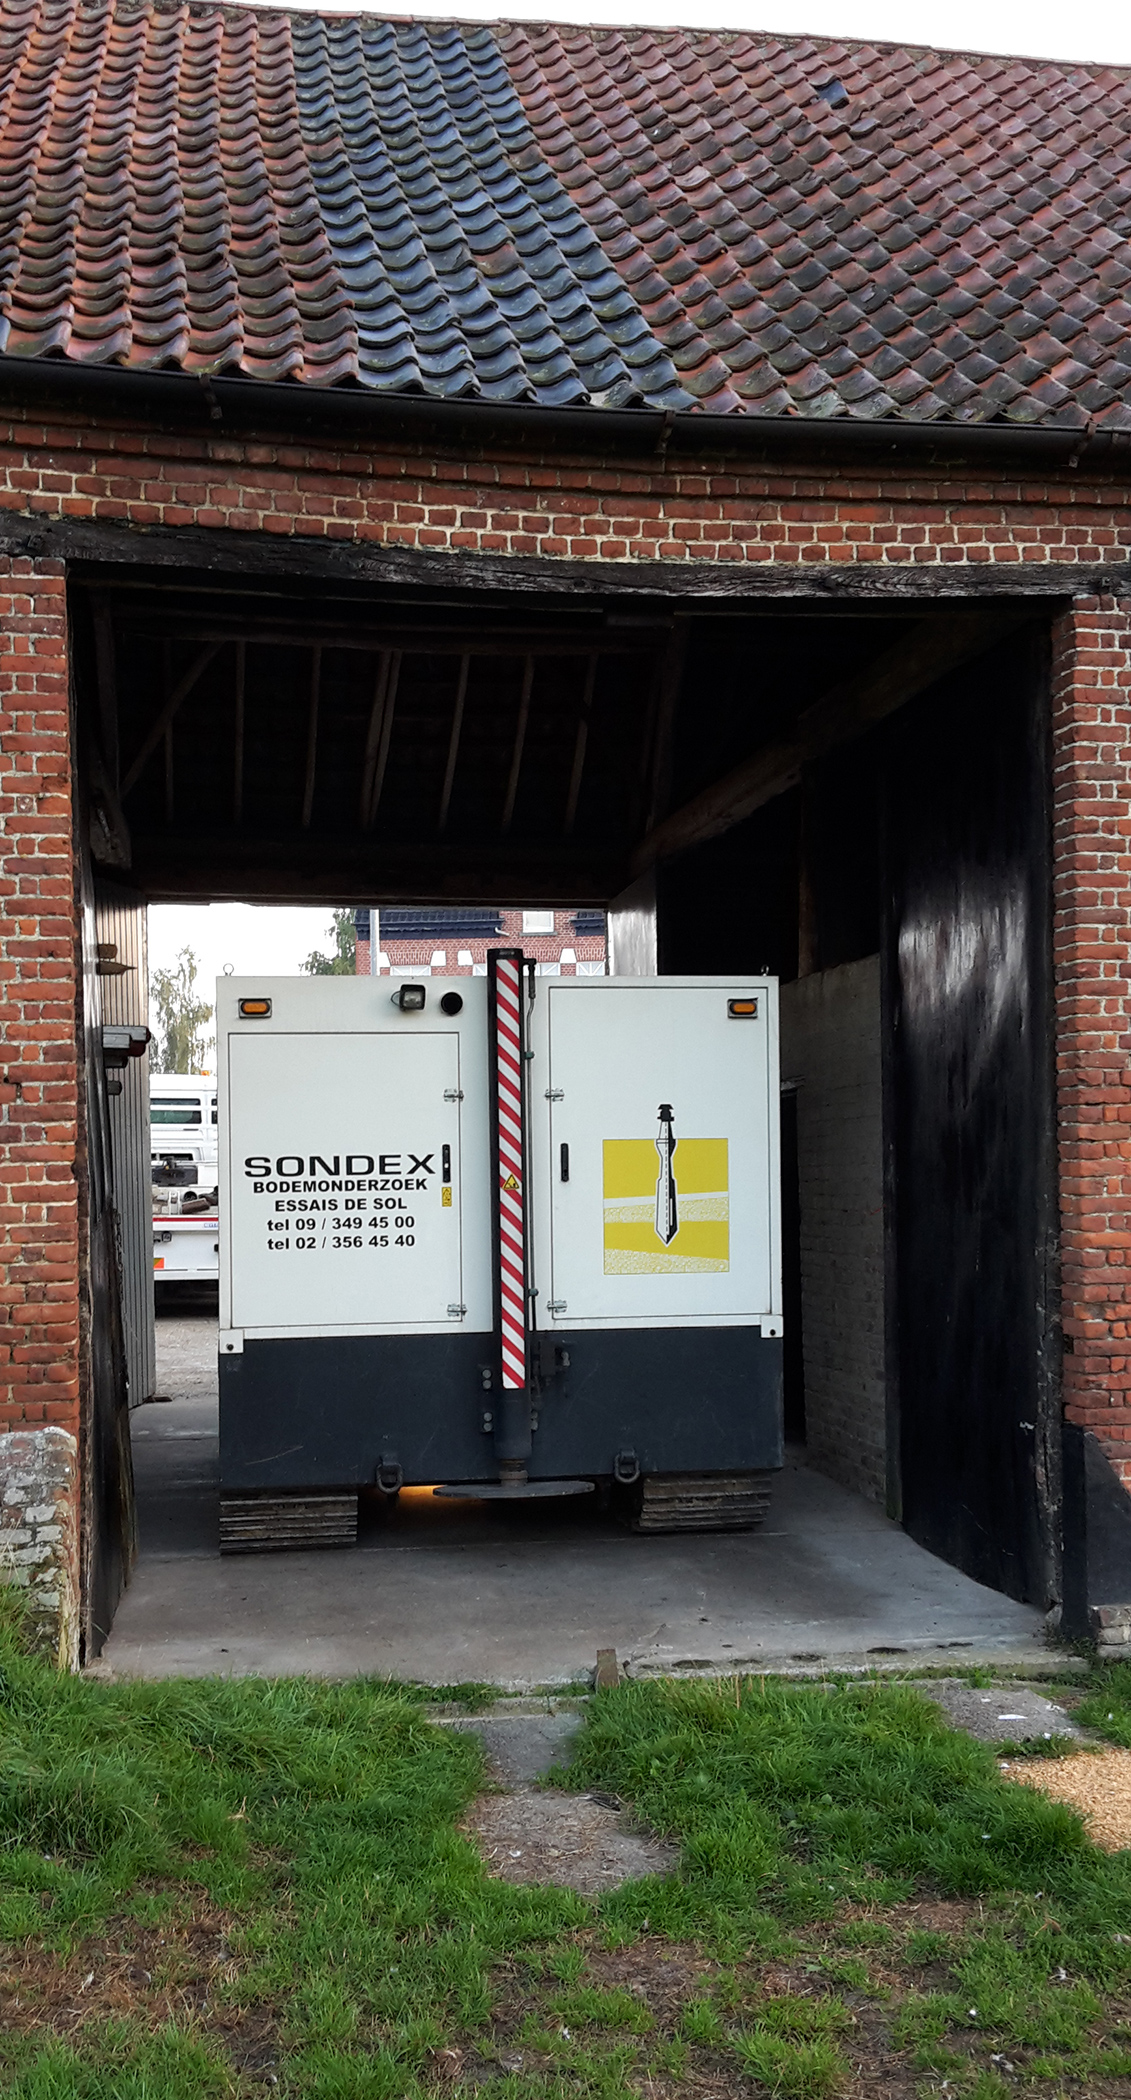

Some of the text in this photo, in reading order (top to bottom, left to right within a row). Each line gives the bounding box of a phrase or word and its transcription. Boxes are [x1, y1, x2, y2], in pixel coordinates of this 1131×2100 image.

[244, 1154, 436, 1178] SONDEX
[253, 1178, 428, 1194] BODEMONDERZOEK
[275, 1197, 408, 1212] ESSAIS DE SOL
[267, 1215, 415, 1231] tel 09 / 349 45 00
[267, 1234, 415, 1250] tel 02 / 356 45 40
